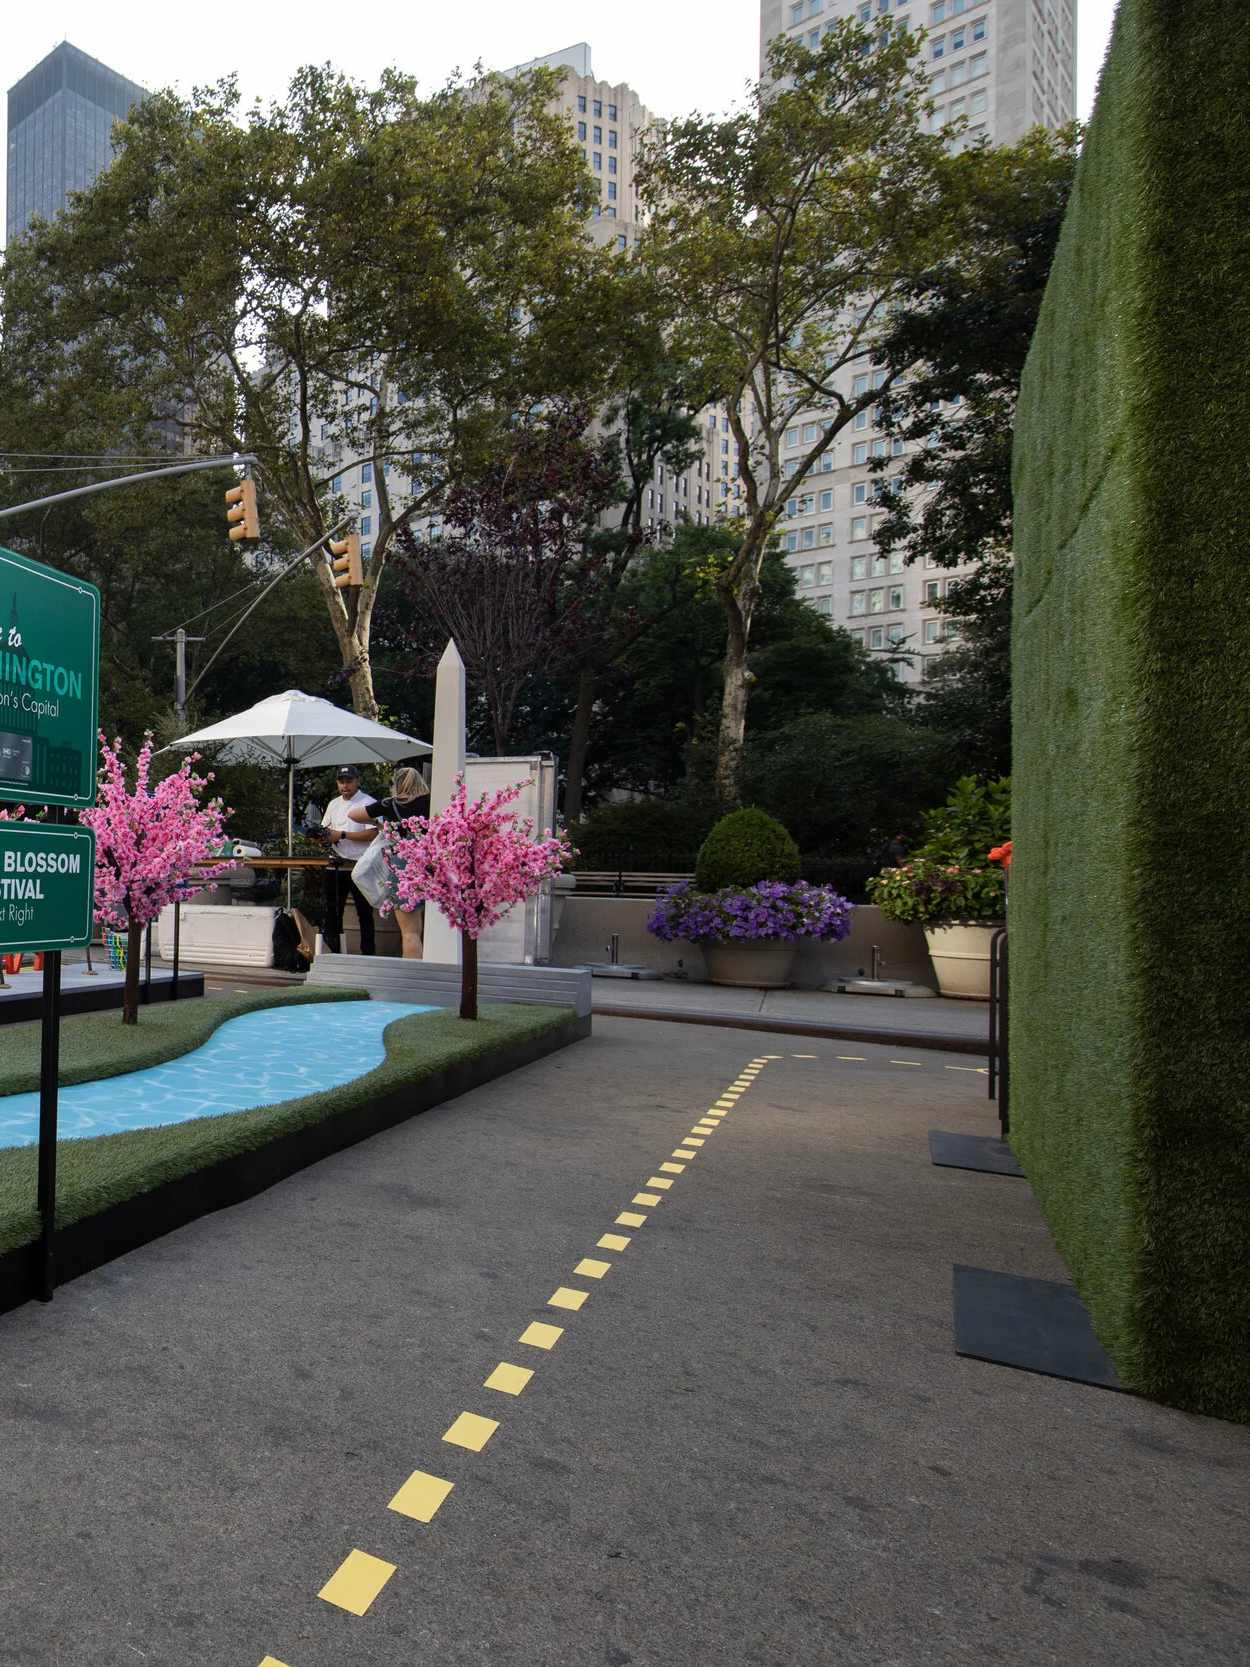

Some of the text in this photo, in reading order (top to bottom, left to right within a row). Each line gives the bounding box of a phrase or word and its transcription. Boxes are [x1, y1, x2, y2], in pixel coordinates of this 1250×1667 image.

[7, 626, 22, 647] to
[21, 693, 59, 719] Capital
[3, 851, 81, 874] BLOSSOM
[8, 902, 34, 926] Right
